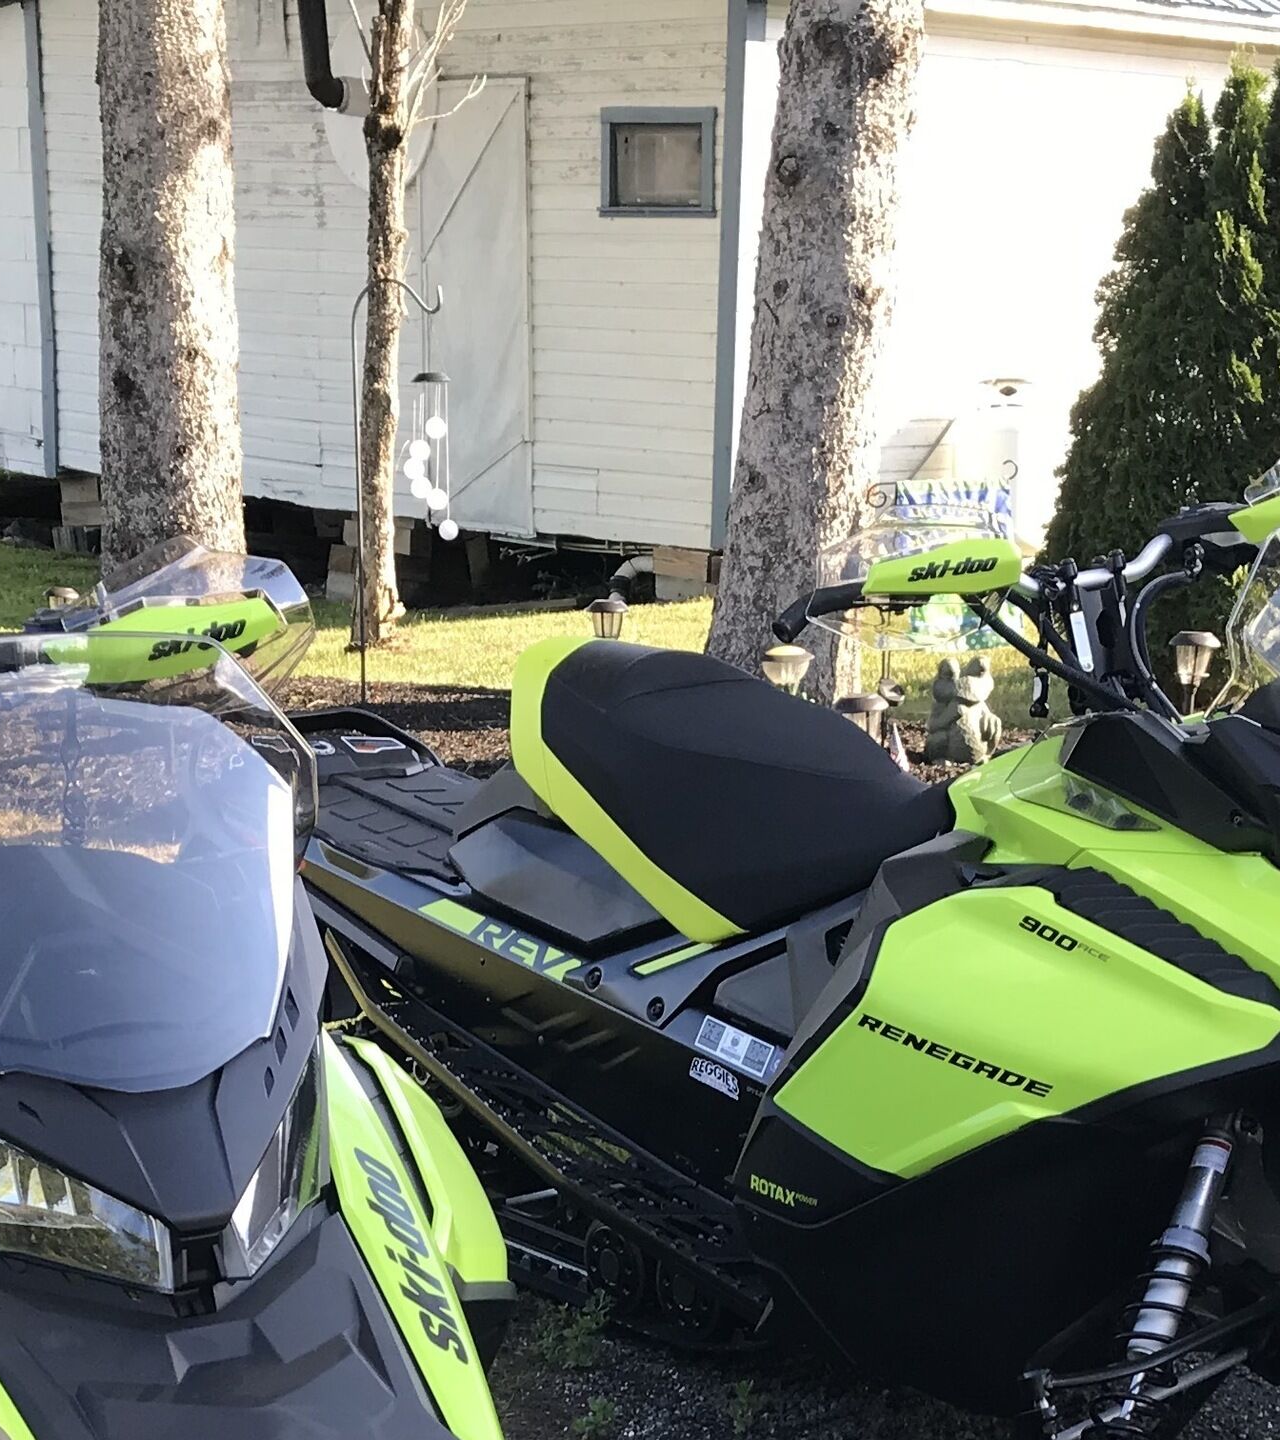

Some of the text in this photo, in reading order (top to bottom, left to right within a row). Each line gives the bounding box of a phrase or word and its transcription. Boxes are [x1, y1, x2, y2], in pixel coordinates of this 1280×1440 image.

[907, 556, 999, 582] ski-doo
[148, 619, 247, 661] ski-doo
[1018, 915, 1079, 953] 900
[855, 1012, 1054, 1098] RENEGADE
[691, 1057, 739, 1097] REGGIES
[750, 1173, 795, 1207] ROTAX
[353, 1146, 469, 1366] ski-doo
